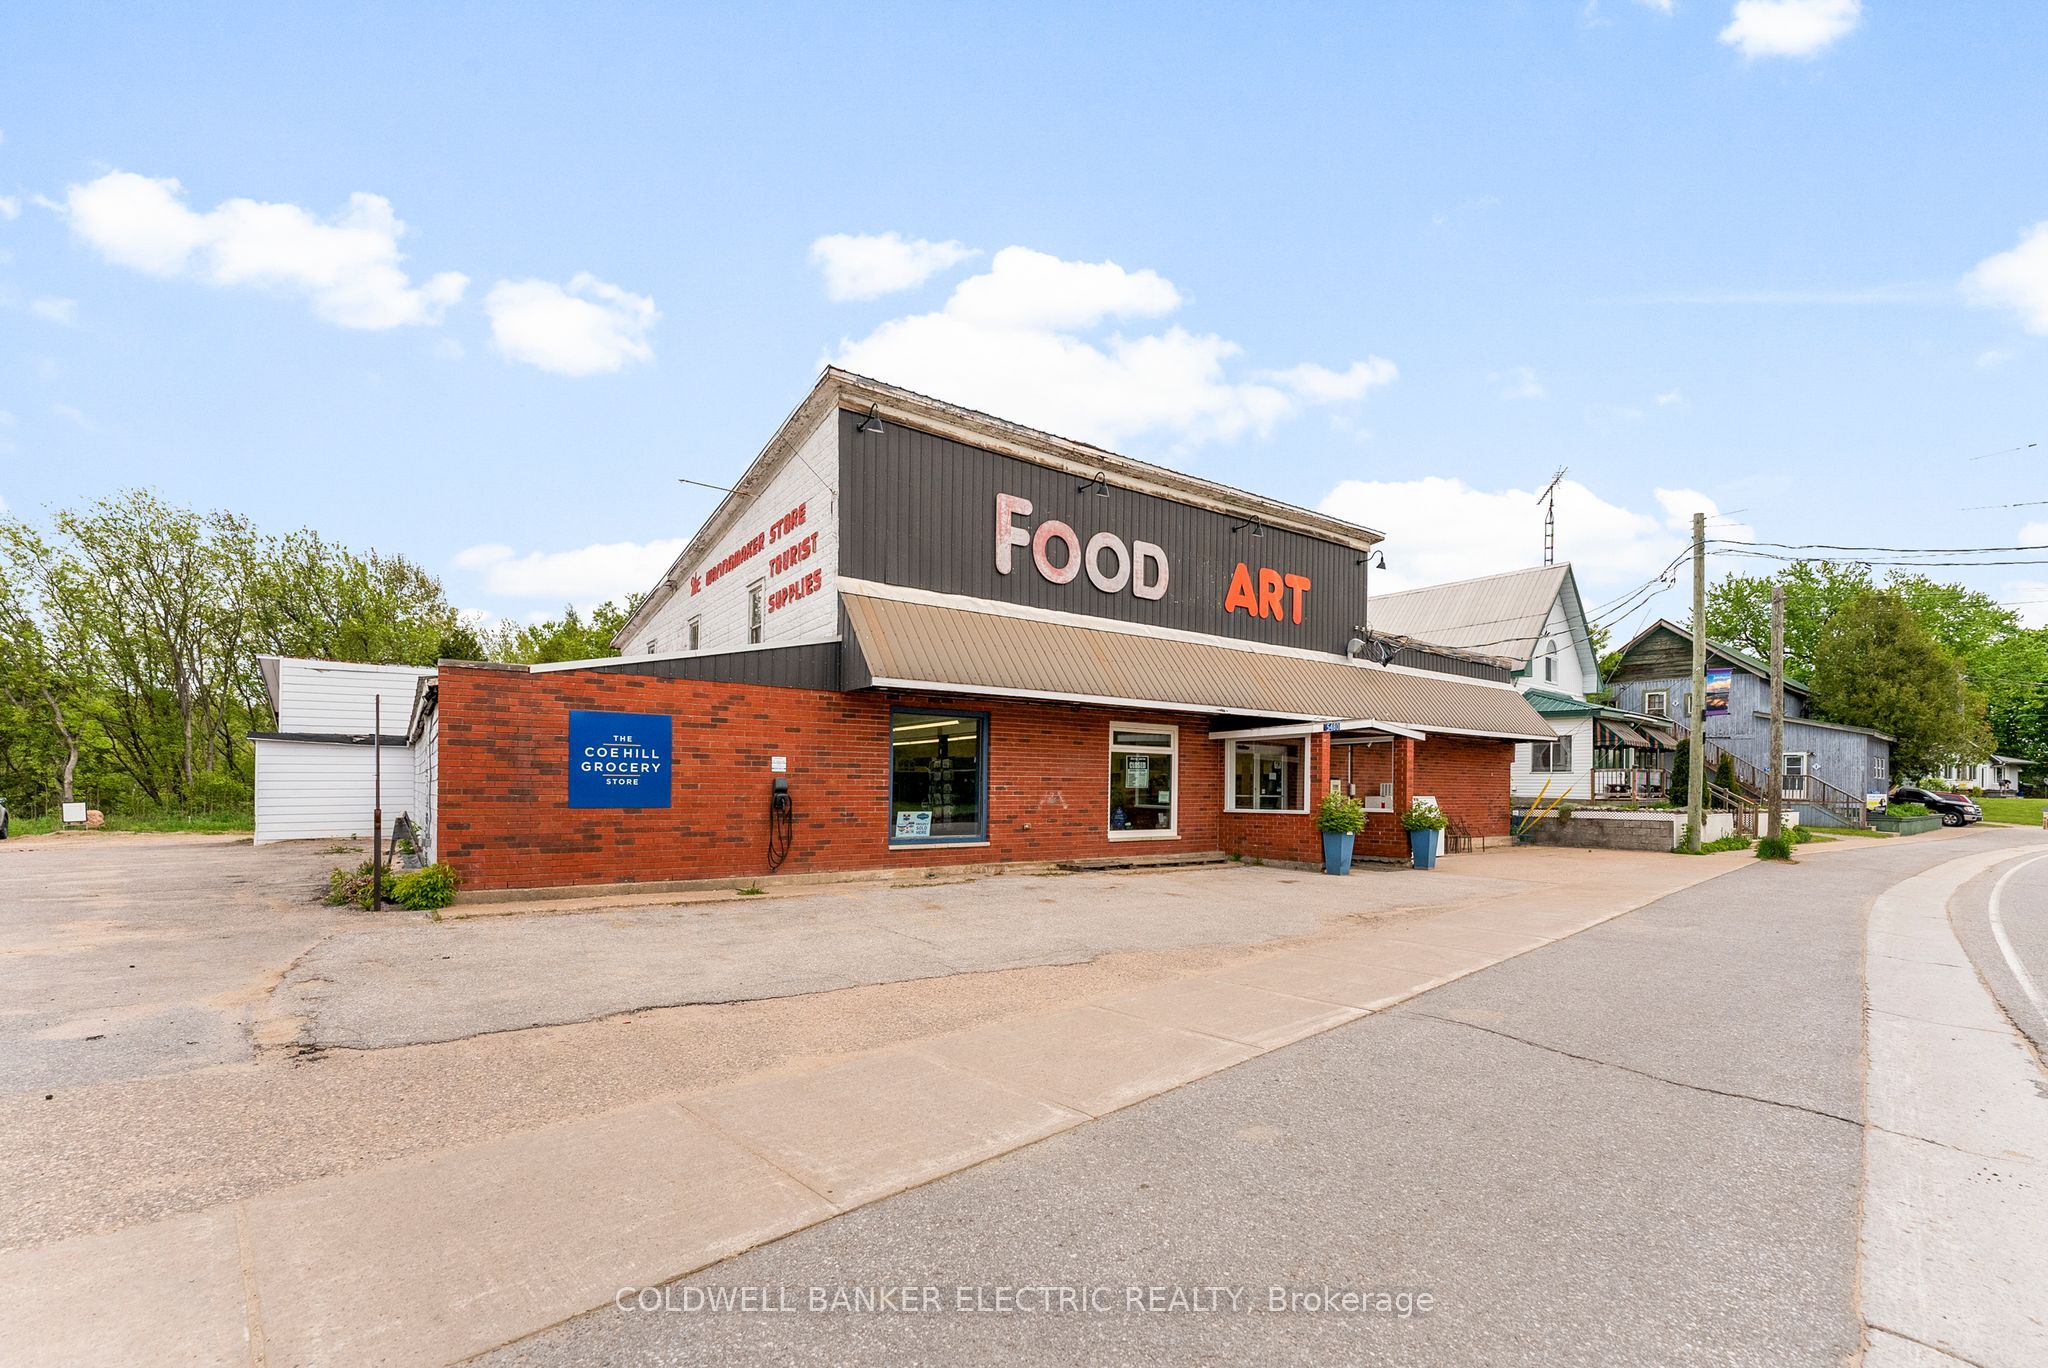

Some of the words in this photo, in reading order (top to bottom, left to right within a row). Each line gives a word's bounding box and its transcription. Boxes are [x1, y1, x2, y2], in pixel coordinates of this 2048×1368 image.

[769, 502, 807, 545] STORE
[768, 531, 819, 578] TOURIST
[996, 493, 1169, 600] FOOD
[767, 568, 822, 614] SUPPLIES
[1224, 562, 1311, 625] ART
[584, 747, 619, 758] COE
[623, 748, 660, 759] HILL
[613, 735, 633, 743] THE
[581, 761, 661, 773] GROCERY
[606, 778, 639, 786] STORE
